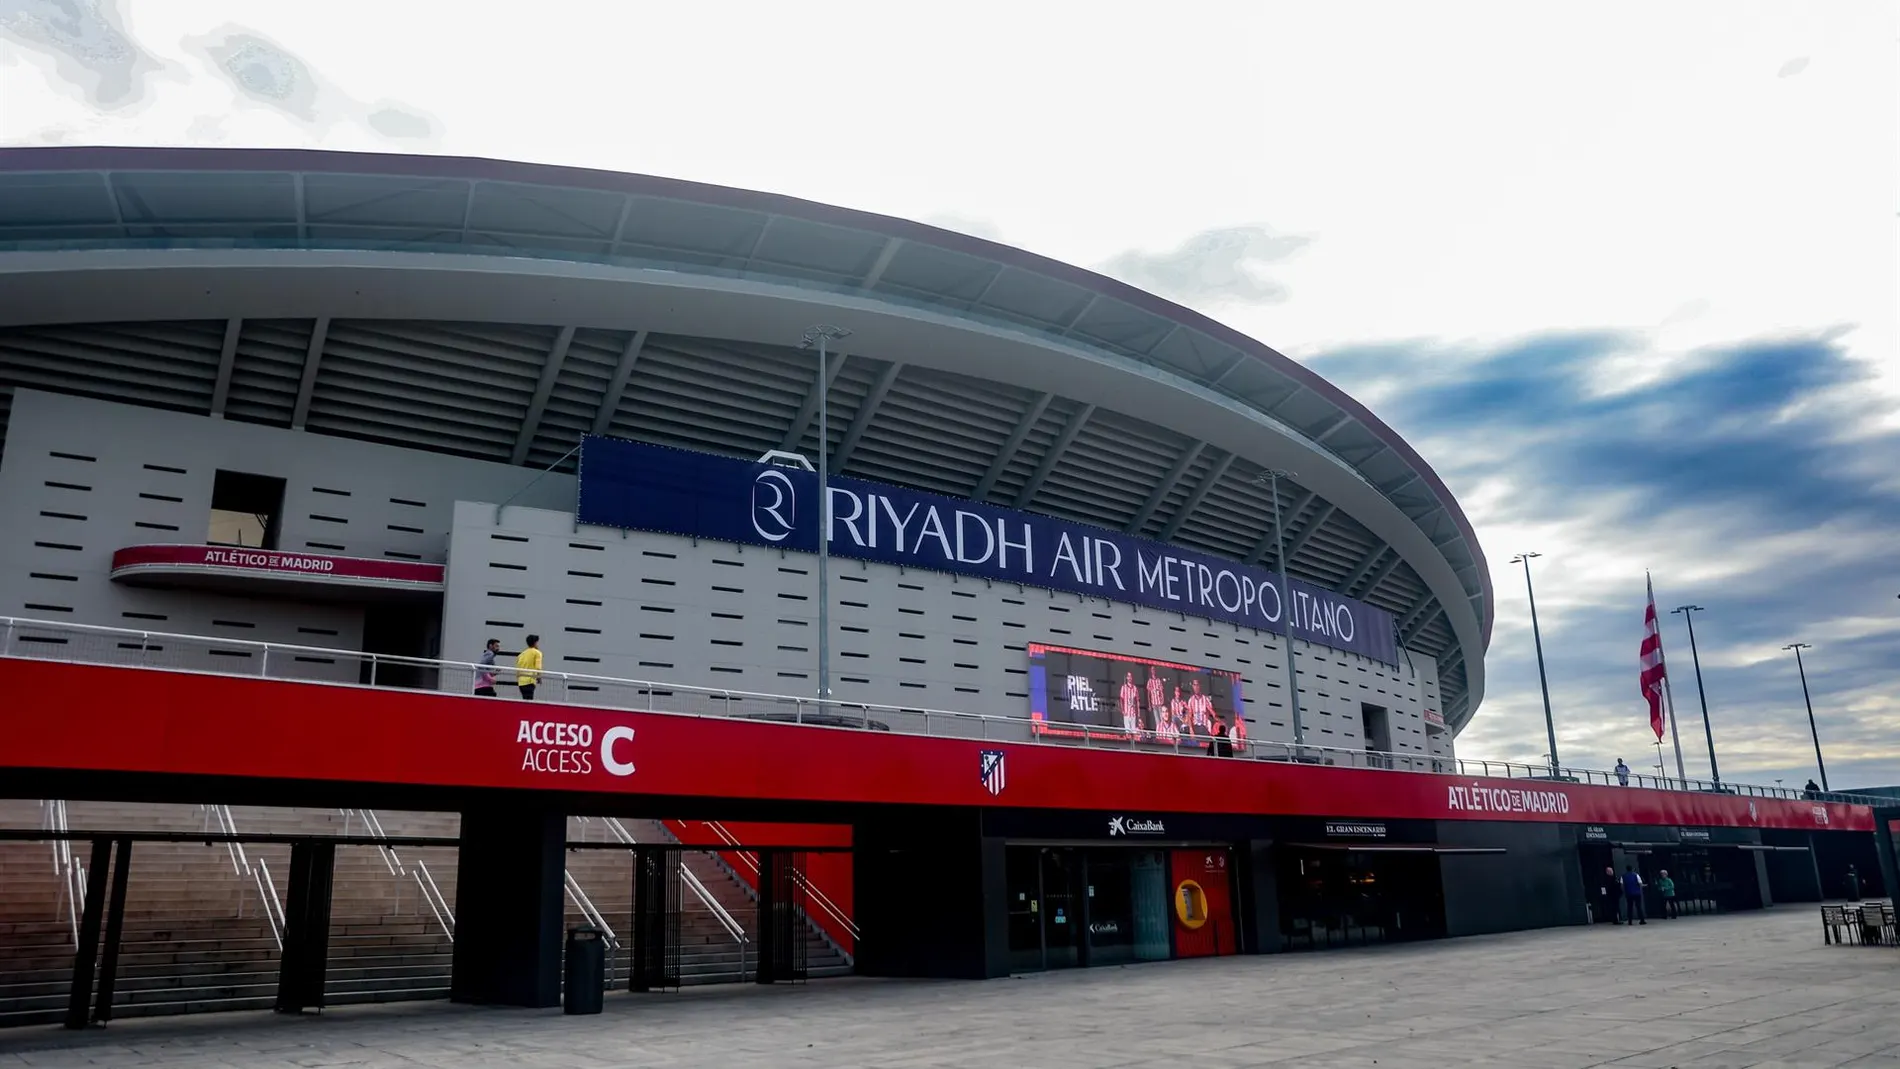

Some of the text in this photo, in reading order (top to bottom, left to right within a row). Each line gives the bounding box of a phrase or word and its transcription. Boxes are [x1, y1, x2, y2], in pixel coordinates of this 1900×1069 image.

[205, 550, 333, 571] ATLÉTICO DE MADRID
[826, 486, 1354, 642] RIYADH AIR METROPOITANO
[517, 720, 592, 747] ACCESO
[522, 748, 592, 774] ACCESS
[601, 726, 636, 776] C
[1448, 781, 1511, 812] ATLÉTICO
[1521, 790, 1569, 813] MADRID
[1126, 818, 1165, 831] CaixaBank
